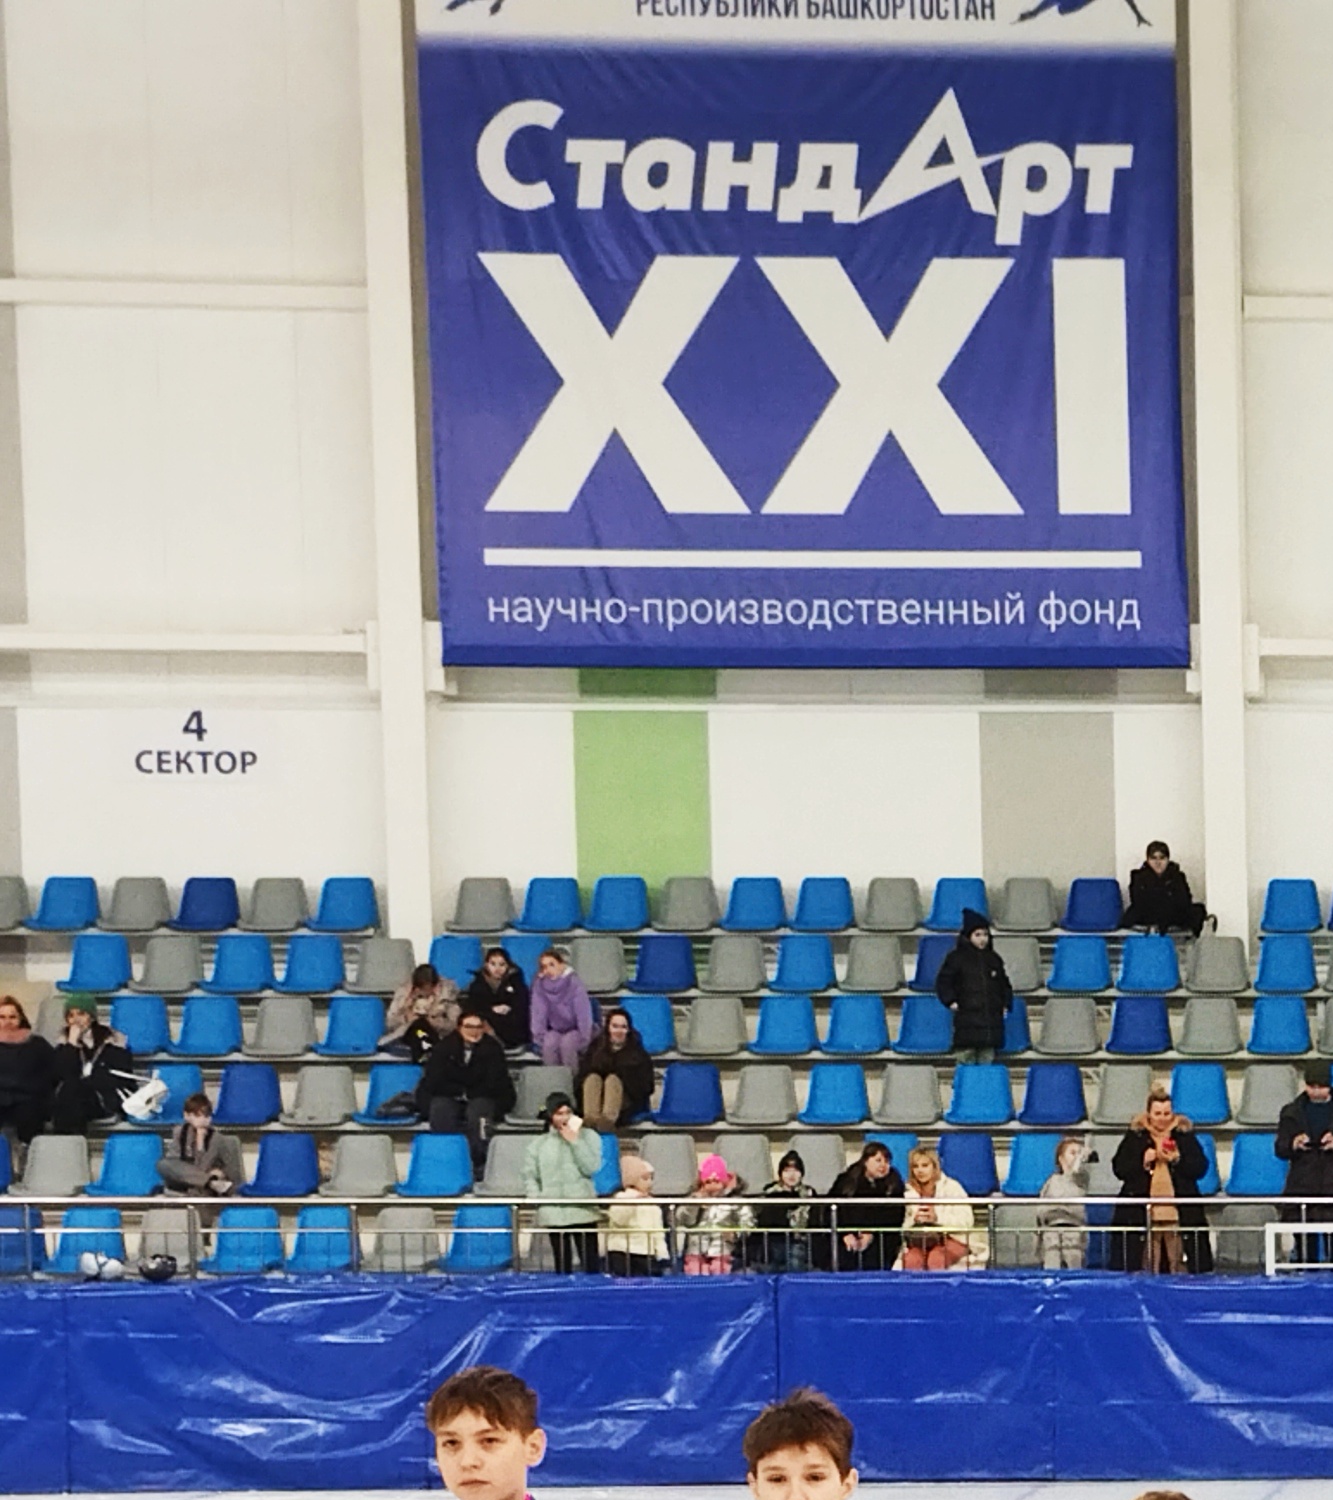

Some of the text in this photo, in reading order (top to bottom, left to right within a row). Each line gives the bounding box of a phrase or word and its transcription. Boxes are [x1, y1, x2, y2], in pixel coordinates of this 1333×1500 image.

[636, 0, 995, 21] РЕСПУБЛИКИ БАШКОРТОСТАН
[476, 87, 1133, 245] СтандАрт
[476, 252, 1132, 515] XXI
[487, 592, 1141, 631] научно-производственный фонд
[182, 710, 207, 742] 4
[135, 749, 257, 774] СЕКТОР
